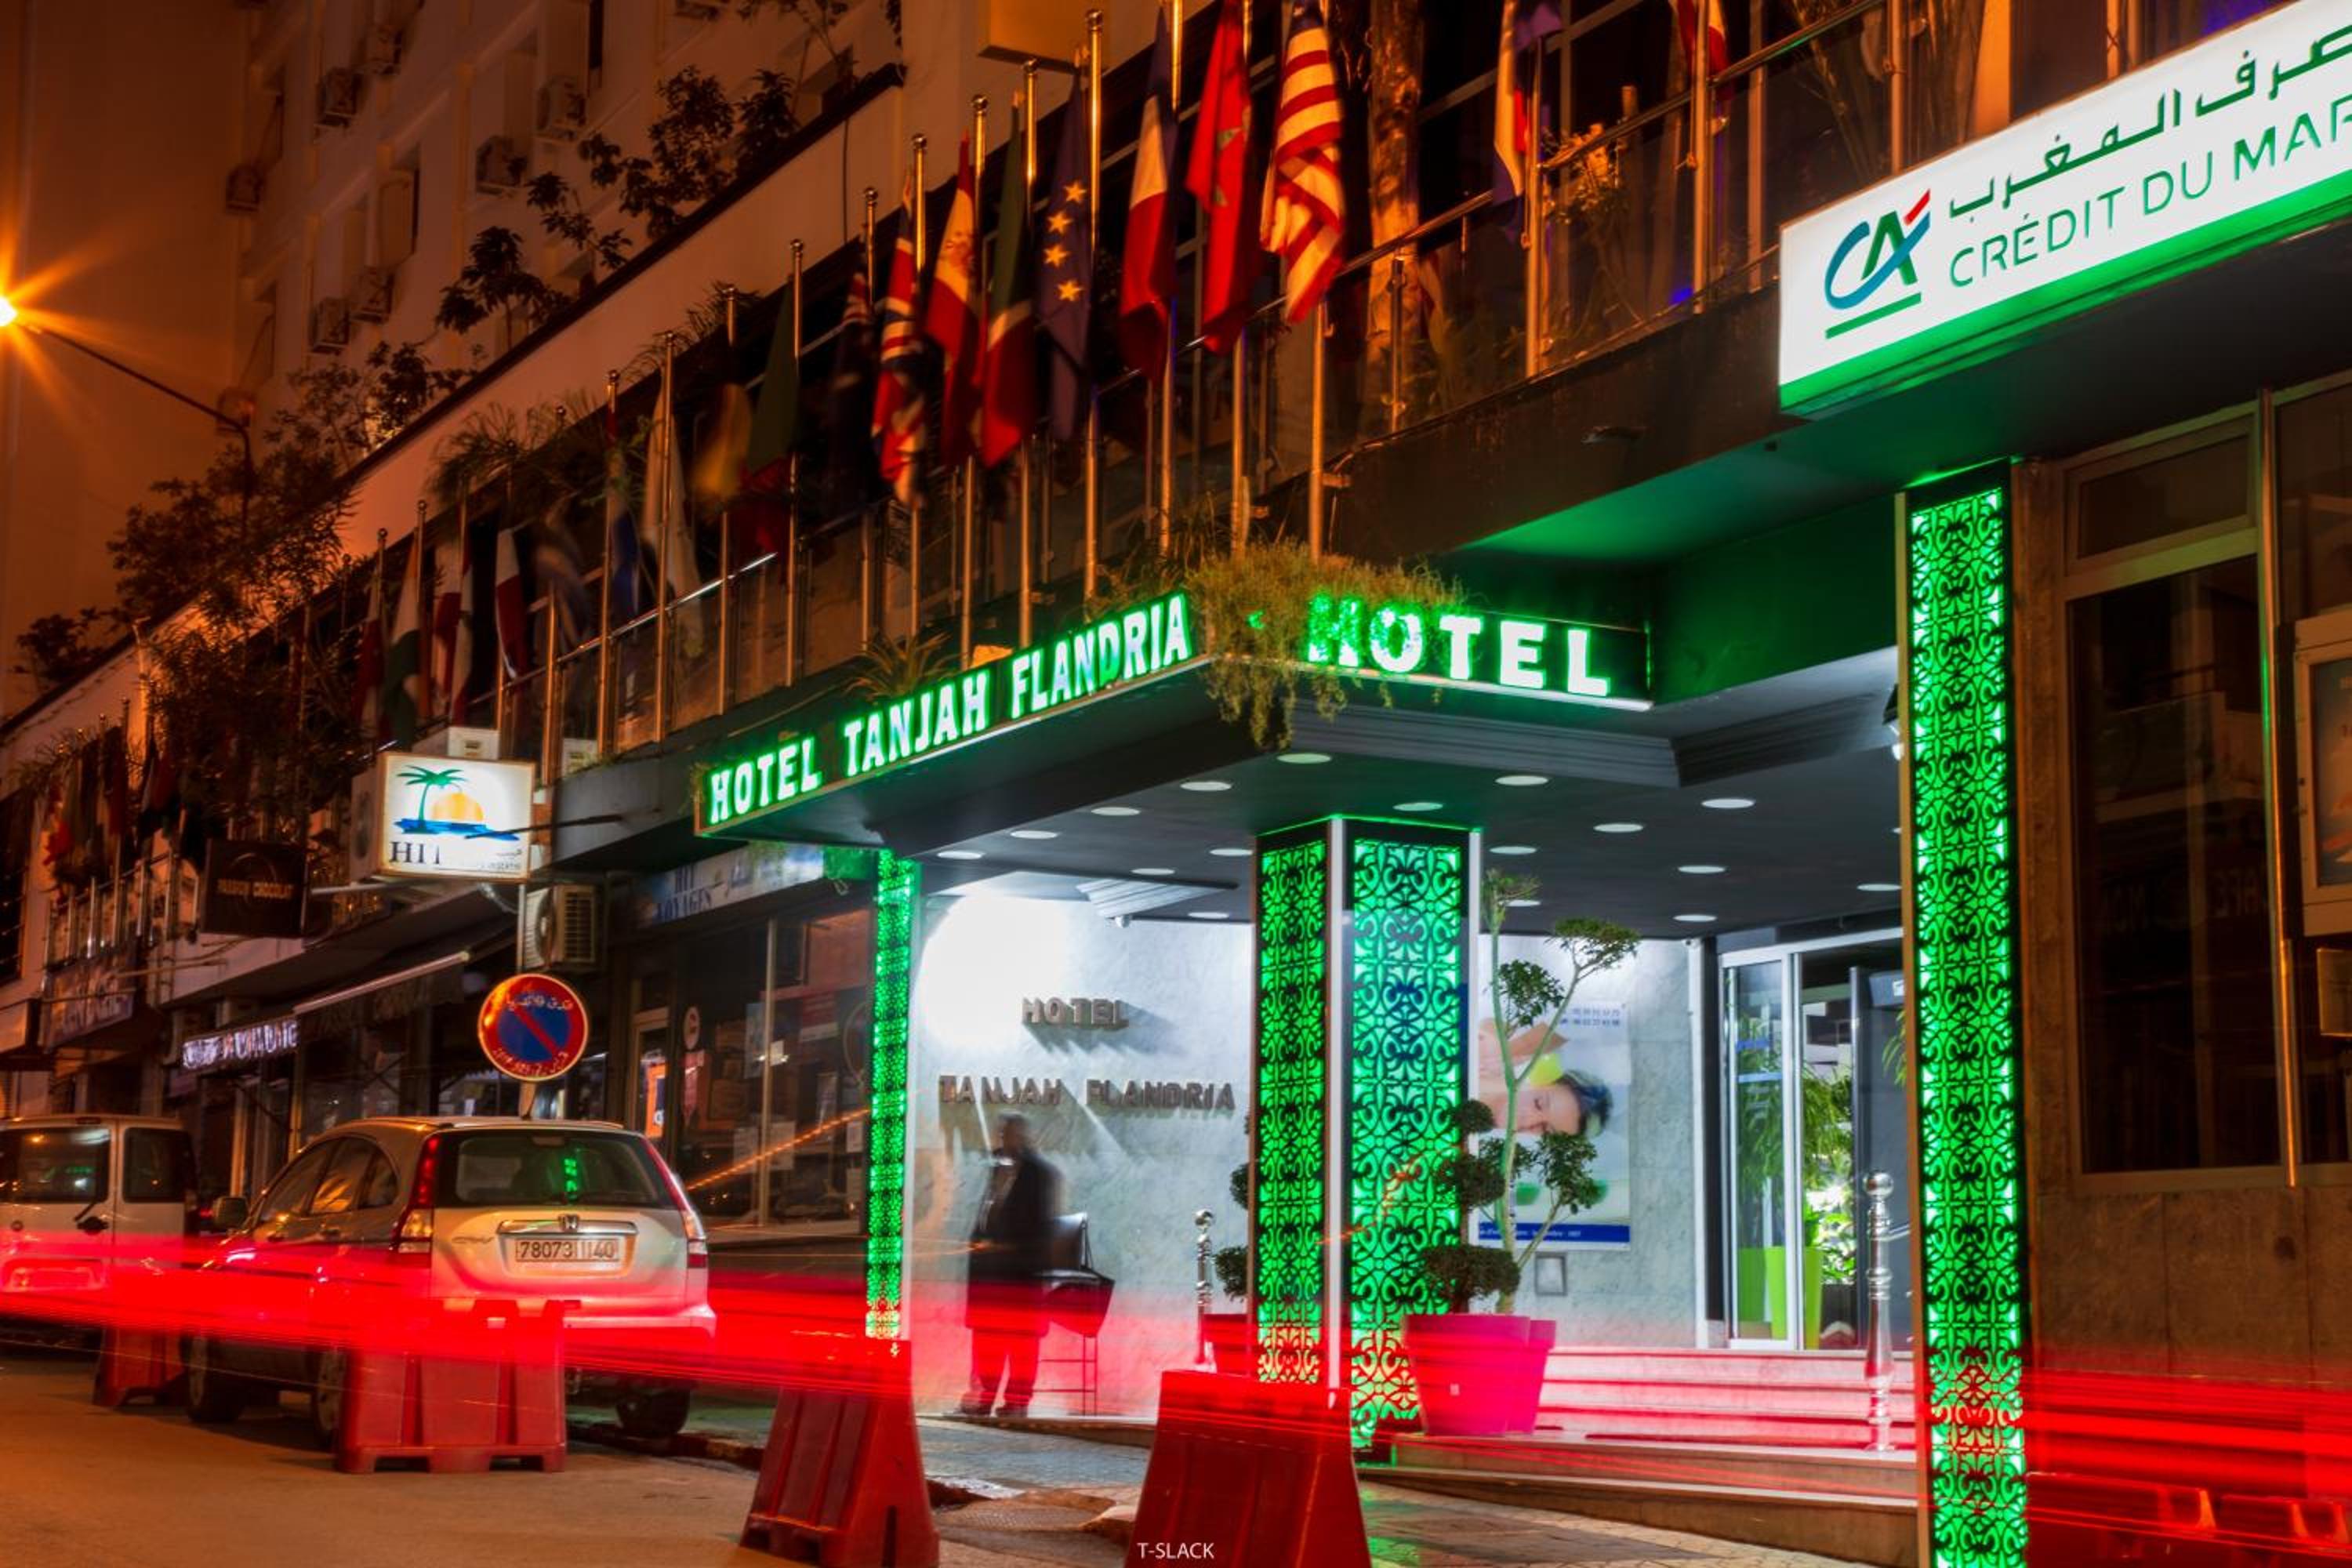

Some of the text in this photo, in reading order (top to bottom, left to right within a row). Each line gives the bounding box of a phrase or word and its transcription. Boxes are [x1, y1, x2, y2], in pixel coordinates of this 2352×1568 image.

[1950, 88, 2181, 223] المغرب
[1950, 185, 2126, 288] CRÉDIT
[2143, 151, 2213, 216] DU
[1308, 593, 1610, 696] HOTEL
[710, 593, 1189, 824] HOTEL TANJAH FLANDRIA
[1022, 996, 1129, 1029] HOTEL
[938, 1075, 1236, 1111] TANJAH FLANDRIA
[520, 1241, 573, 1258] 78073
